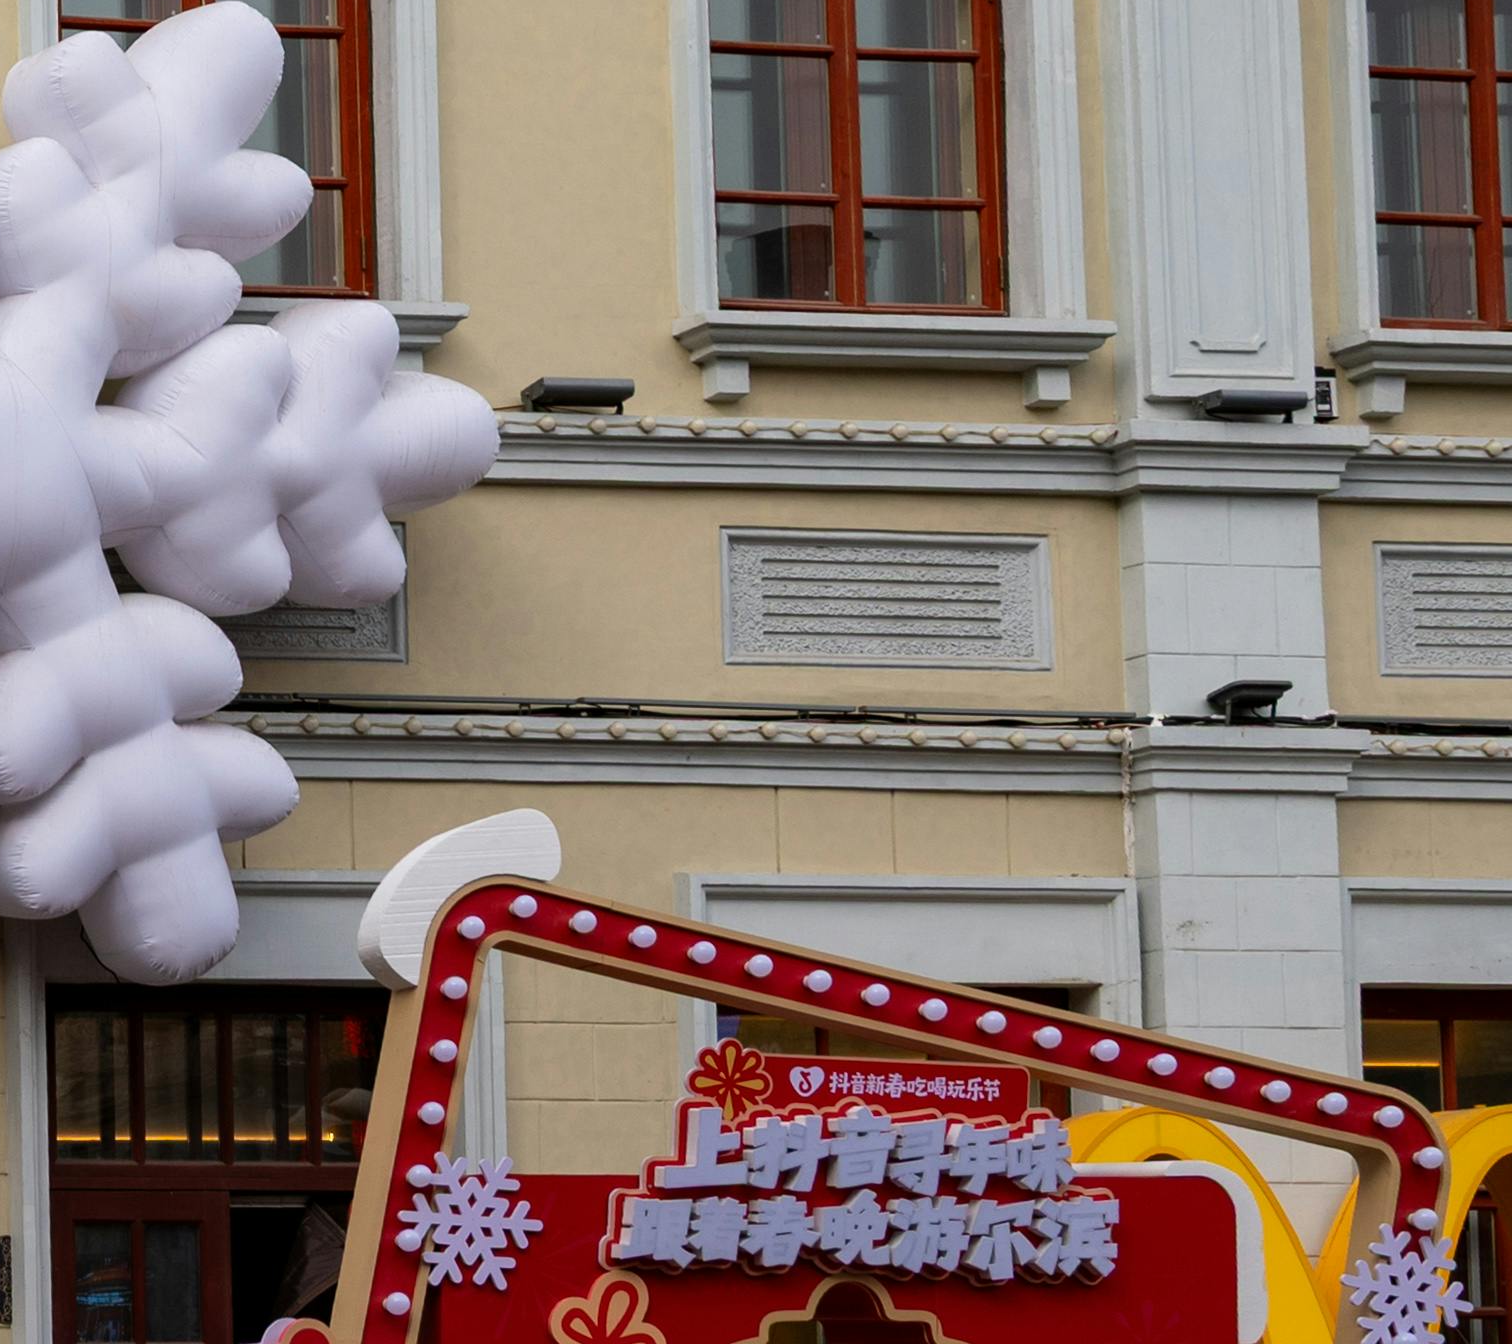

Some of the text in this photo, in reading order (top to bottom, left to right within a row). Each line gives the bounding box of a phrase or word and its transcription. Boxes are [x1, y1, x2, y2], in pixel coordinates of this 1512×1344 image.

[829, 1071, 1001, 1102] 抖音新春吃喝玩乐节
[654, 1104, 1076, 1196] 上抖音寻年味
[610, 1188, 1120, 1281] 跟着春晚游尔滨
